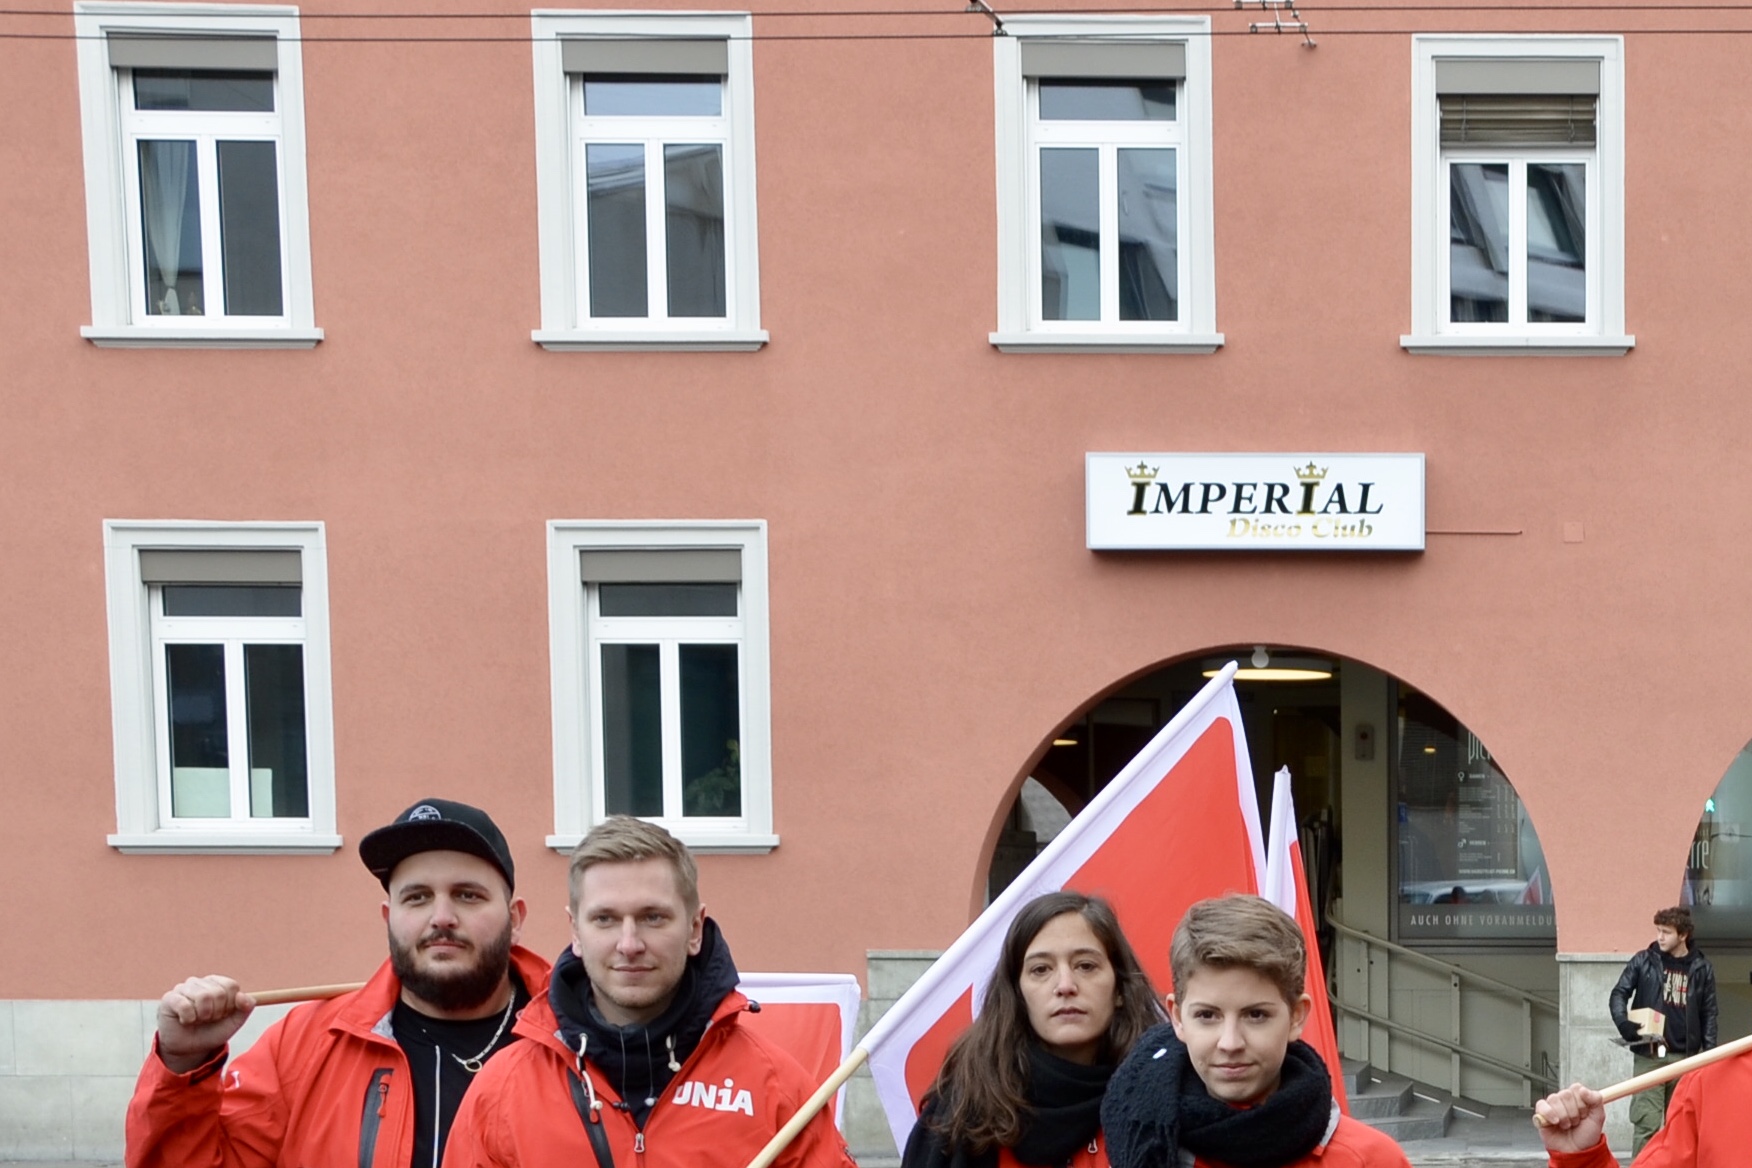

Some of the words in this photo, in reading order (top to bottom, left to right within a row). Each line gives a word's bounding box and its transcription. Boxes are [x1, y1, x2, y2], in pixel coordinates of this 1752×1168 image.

[1127, 481, 1384, 516] IMPERIAL
[1227, 518, 1302, 538] Disco
[1312, 518, 1374, 538] Club
[1410, 915, 1439, 925] AUCH
[1445, 915, 1473, 926] OHNE
[1480, 915, 1556, 926] VORANMELDU
